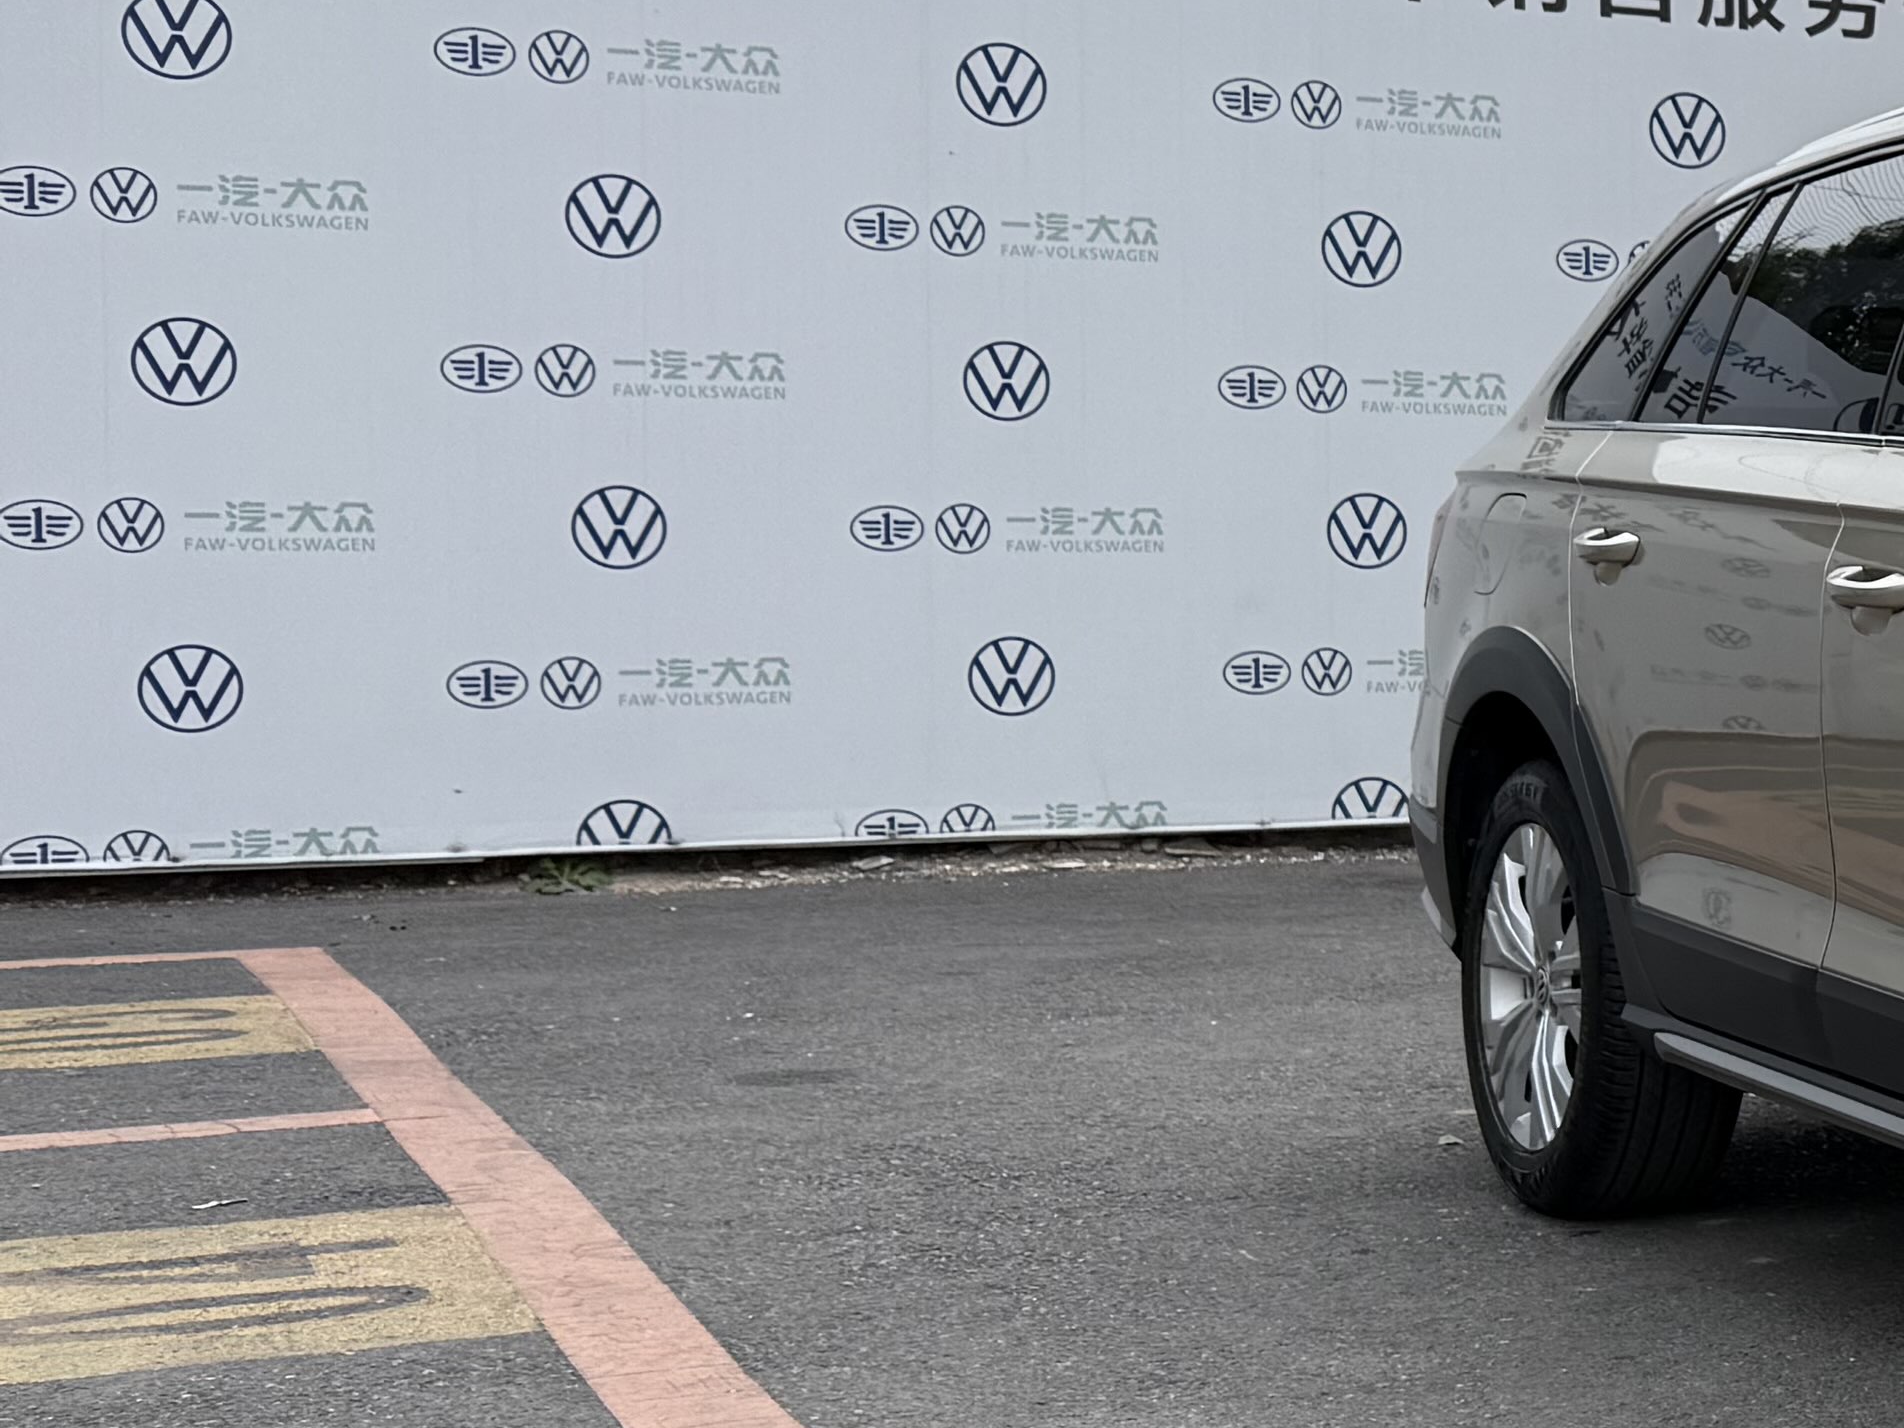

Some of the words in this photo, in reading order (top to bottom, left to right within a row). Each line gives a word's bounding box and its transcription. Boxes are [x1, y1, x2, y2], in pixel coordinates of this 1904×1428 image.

[607, 71, 781, 94] FAW-VOLKSWAGEN
[1356, 117, 1502, 140] FAW-VOLKSWAGEN
[177, 210, 369, 231] FAW-VOLKSWAGEN
[1001, 244, 1159, 263] FAW-VOLKSWAGEN
[612, 383, 786, 400] FAW-VOLKSWAGEN
[1361, 400, 1508, 417] FAW-VOLKSWAGEN
[184, 536, 376, 553] FAW-VOLKSWAGEN
[1006, 538, 1165, 553] FAW-VOLKSWAGEN
[618, 690, 792, 707] FAW-VOLKSWAGEN
